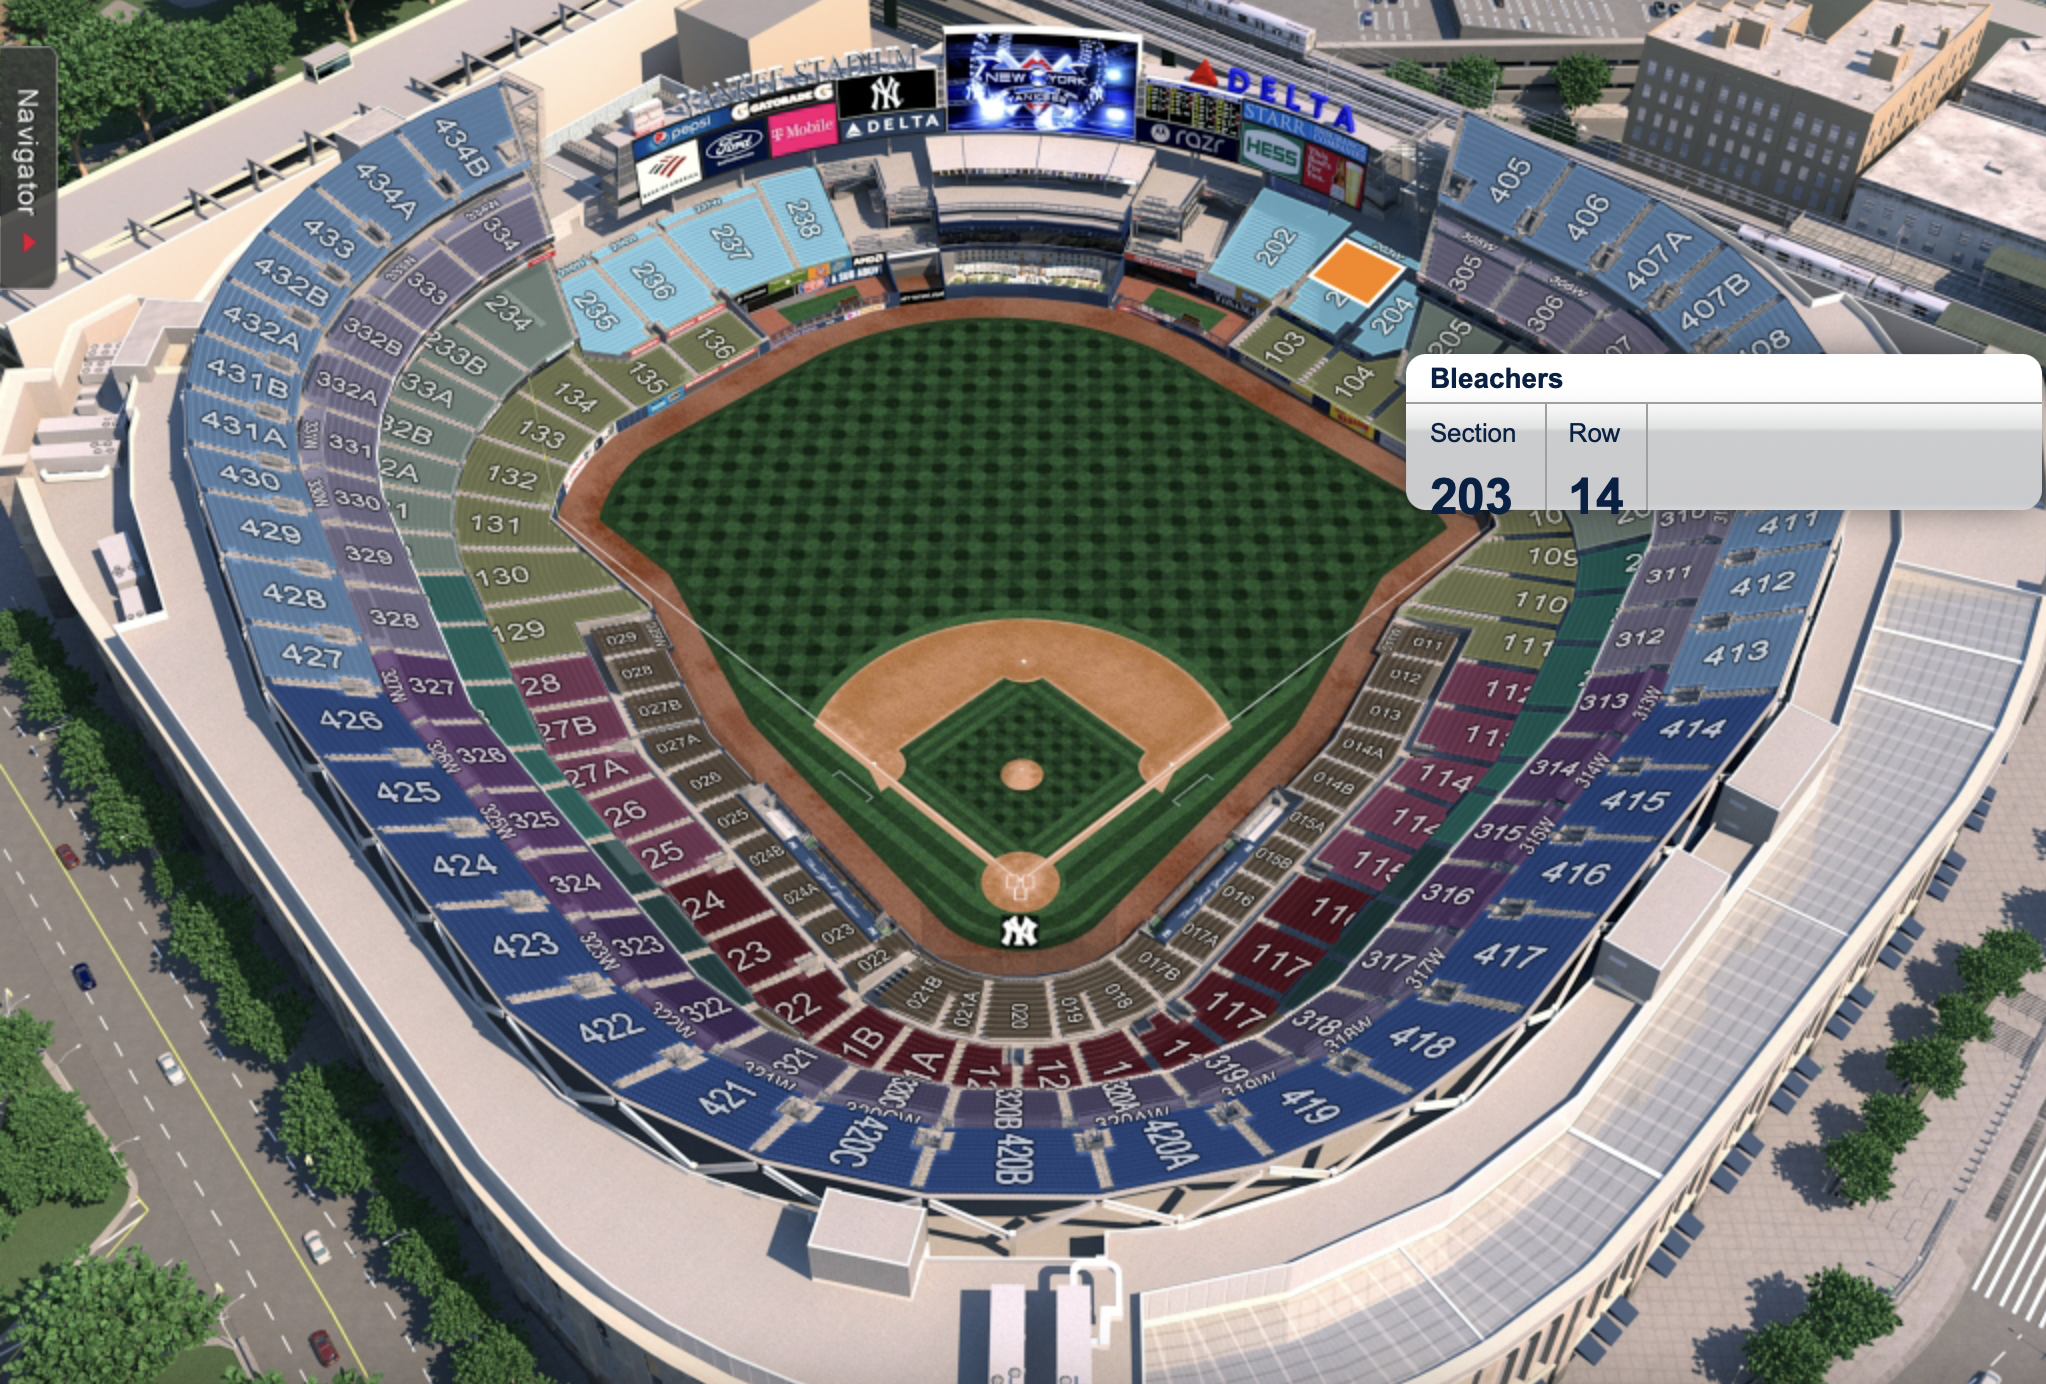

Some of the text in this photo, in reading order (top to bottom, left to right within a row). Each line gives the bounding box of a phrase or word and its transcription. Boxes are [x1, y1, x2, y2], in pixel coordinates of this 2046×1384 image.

[793, 44, 918, 84] STADIUM
[985, 72, 1088, 86] NEW YORK
[750, 90, 813, 113] GATORADE
[870, 75, 901, 111] NY
[1228, 67, 1356, 133] DELTA
[671, 116, 711, 140] pepsi
[786, 119, 834, 138] Mobile
[867, 114, 940, 133] DELTA
[1244, 101, 1307, 138] STARR
[435, 118, 491, 177] 434B
[716, 134, 752, 155] Ford
[1176, 129, 1225, 153] razr
[1246, 136, 1298, 168] HESS
[356, 164, 417, 221] 434A
[1490, 157, 1531, 204] 405
[786, 199, 822, 239] 238
[1567, 194, 1609, 241] 406
[304, 220, 355, 259] 433
[484, 218, 521, 252] 334
[711, 225, 753, 261] 237
[1255, 228, 1297, 267] 202
[1449, 254, 1483, 293] 305
[1626, 231, 1692, 291] 407A
[254, 259, 329, 307] 432B
[407, 272, 448, 305] 333
[631, 261, 676, 300] 236
[484, 295, 533, 332] 234
[572, 291, 619, 331] 235
[1528, 294, 1564, 333] 306
[1681, 273, 1750, 331] 407B
[1370, 296, 1415, 336] 204
[223, 307, 299, 352] 432A
[343, 317, 403, 356] 332B
[424, 331, 487, 376] 233B
[697, 327, 736, 359] 136
[1265, 331, 1305, 364] 103
[207, 359, 289, 399] 431B
[316, 371, 378, 406] 332A
[629, 362, 669, 395] 135
[1334, 365, 1375, 398] 104
[554, 382, 599, 414] 134
[201, 411, 287, 449] 431A
[519, 420, 566, 449] 133
[329, 434, 371, 458] 331
[219, 465, 280, 491] 430
[488, 465, 538, 490] 132
[334, 490, 381, 511] 330
[240, 519, 301, 544] 429
[471, 514, 520, 535] 131
[1757, 510, 1819, 535] 411
[345, 546, 393, 565] 329
[475, 566, 529, 587] 130
[1646, 565, 1692, 584] 311
[1730, 571, 1796, 596] 412
[263, 583, 327, 609] 428
[1516, 591, 1568, 613] 110
[369, 609, 420, 628] 328
[493, 620, 545, 643] 129
[606, 631, 637, 646] 029
[1413, 637, 1443, 650] 011
[1504, 634, 1554, 657] 111
[1615, 628, 1665, 648] 312
[281, 643, 343, 669] 427
[1703, 640, 1769, 666] 413
[521, 673, 561, 697] 28
[622, 666, 653, 680] 028
[1389, 669, 1422, 685] 012
[408, 677, 454, 696] 327
[638, 700, 682, 717] 027B
[1369, 705, 1402, 721] 013
[1579, 693, 1629, 711] 313
[320, 710, 383, 730] 426
[1659, 718, 1727, 739] 414
[456, 748, 507, 764] 326
[656, 734, 702, 754] 027A
[1342, 738, 1385, 760] 014A
[563, 759, 628, 789] 27A
[690, 772, 722, 790] 026
[1420, 763, 1474, 793] 114
[1529, 759, 1580, 777] 314
[1574, 751, 1611, 789] 314W
[377, 781, 441, 802] 425
[1313, 771, 1355, 795] 014B
[1600, 789, 1672, 812] 415
[509, 811, 560, 829] 325
[604, 800, 646, 828] 26
[717, 809, 749, 829] 025
[1289, 811, 1326, 833] 015A
[1473, 823, 1526, 842] 315
[433, 853, 498, 877] 424
[642, 840, 684, 870] 25
[750, 845, 785, 866] 024B
[1254, 847, 1293, 869] 015B
[549, 873, 601, 893] 324
[1541, 861, 1612, 886] 416
[682, 889, 726, 920] 24
[783, 883, 819, 904] 024A
[1221, 885, 1255, 906] 016
[1421, 883, 1475, 906] 316
[493, 932, 559, 958] 423
[612, 935, 665, 957] 323
[821, 923, 854, 945] 023
[1181, 921, 1220, 947] 017A
[580, 931, 621, 971] 323W
[727, 941, 772, 972] 23
[857, 949, 891, 972] 022
[1252, 944, 1312, 978] 117
[1361, 950, 1416, 973] 317
[1473, 942, 1549, 969] 417
[1138, 951, 1181, 981] 017B
[1405, 947, 1446, 990] 317W
[906, 976, 942, 1009] 021B
[1105, 983, 1133, 1009] 018
[680, 997, 732, 1022] 322
[775, 992, 822, 1024] 22
[953, 991, 980, 1027] 021A
[1011, 1003, 1028, 1029] 020
[1061, 996, 1084, 1023] 019
[1207, 991, 1266, 1028] 117
[579, 1013, 647, 1044] 422
[1291, 1010, 1343, 1037] 318
[1390, 1026, 1456, 1058] 418
[773, 1047, 818, 1076] 321
[1205, 1055, 1249, 1082] 319
[698, 1080, 757, 1115] 421
[994, 1088, 1023, 1130] 320B
[1281, 1089, 1341, 1124] 419
[829, 1115, 889, 1168] 420C
[1144, 1120, 1200, 1172] 420A
[995, 1133, 1034, 1185] 420B
